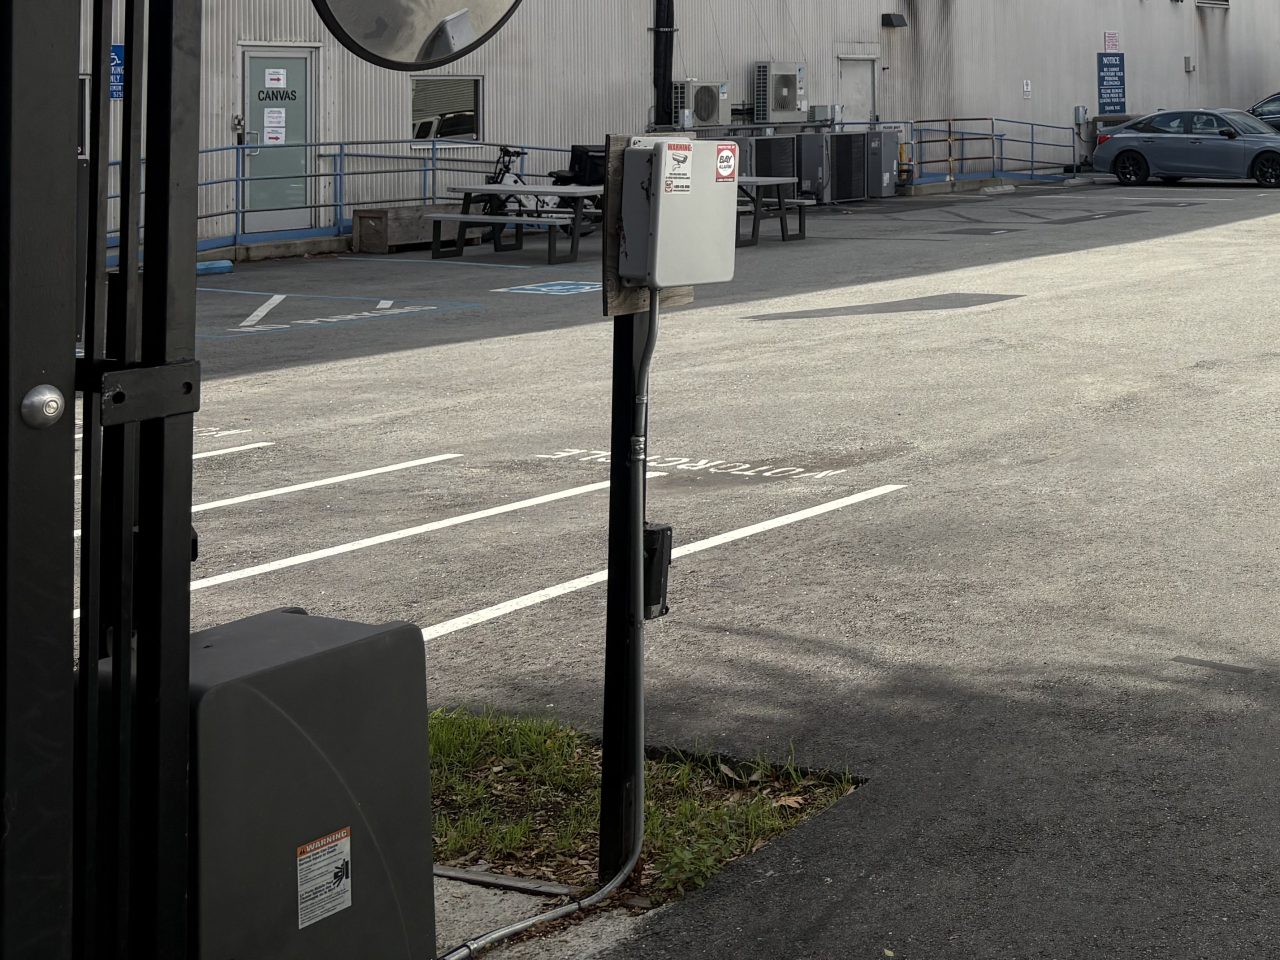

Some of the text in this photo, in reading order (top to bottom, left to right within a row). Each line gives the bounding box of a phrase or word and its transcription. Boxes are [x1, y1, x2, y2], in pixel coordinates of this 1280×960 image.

[1103, 56, 1120, 64] NOTICE
[258, 90, 297, 101] CANVAS
[720, 155, 732, 163] BAY
[306, 830, 347, 852] WARNING
